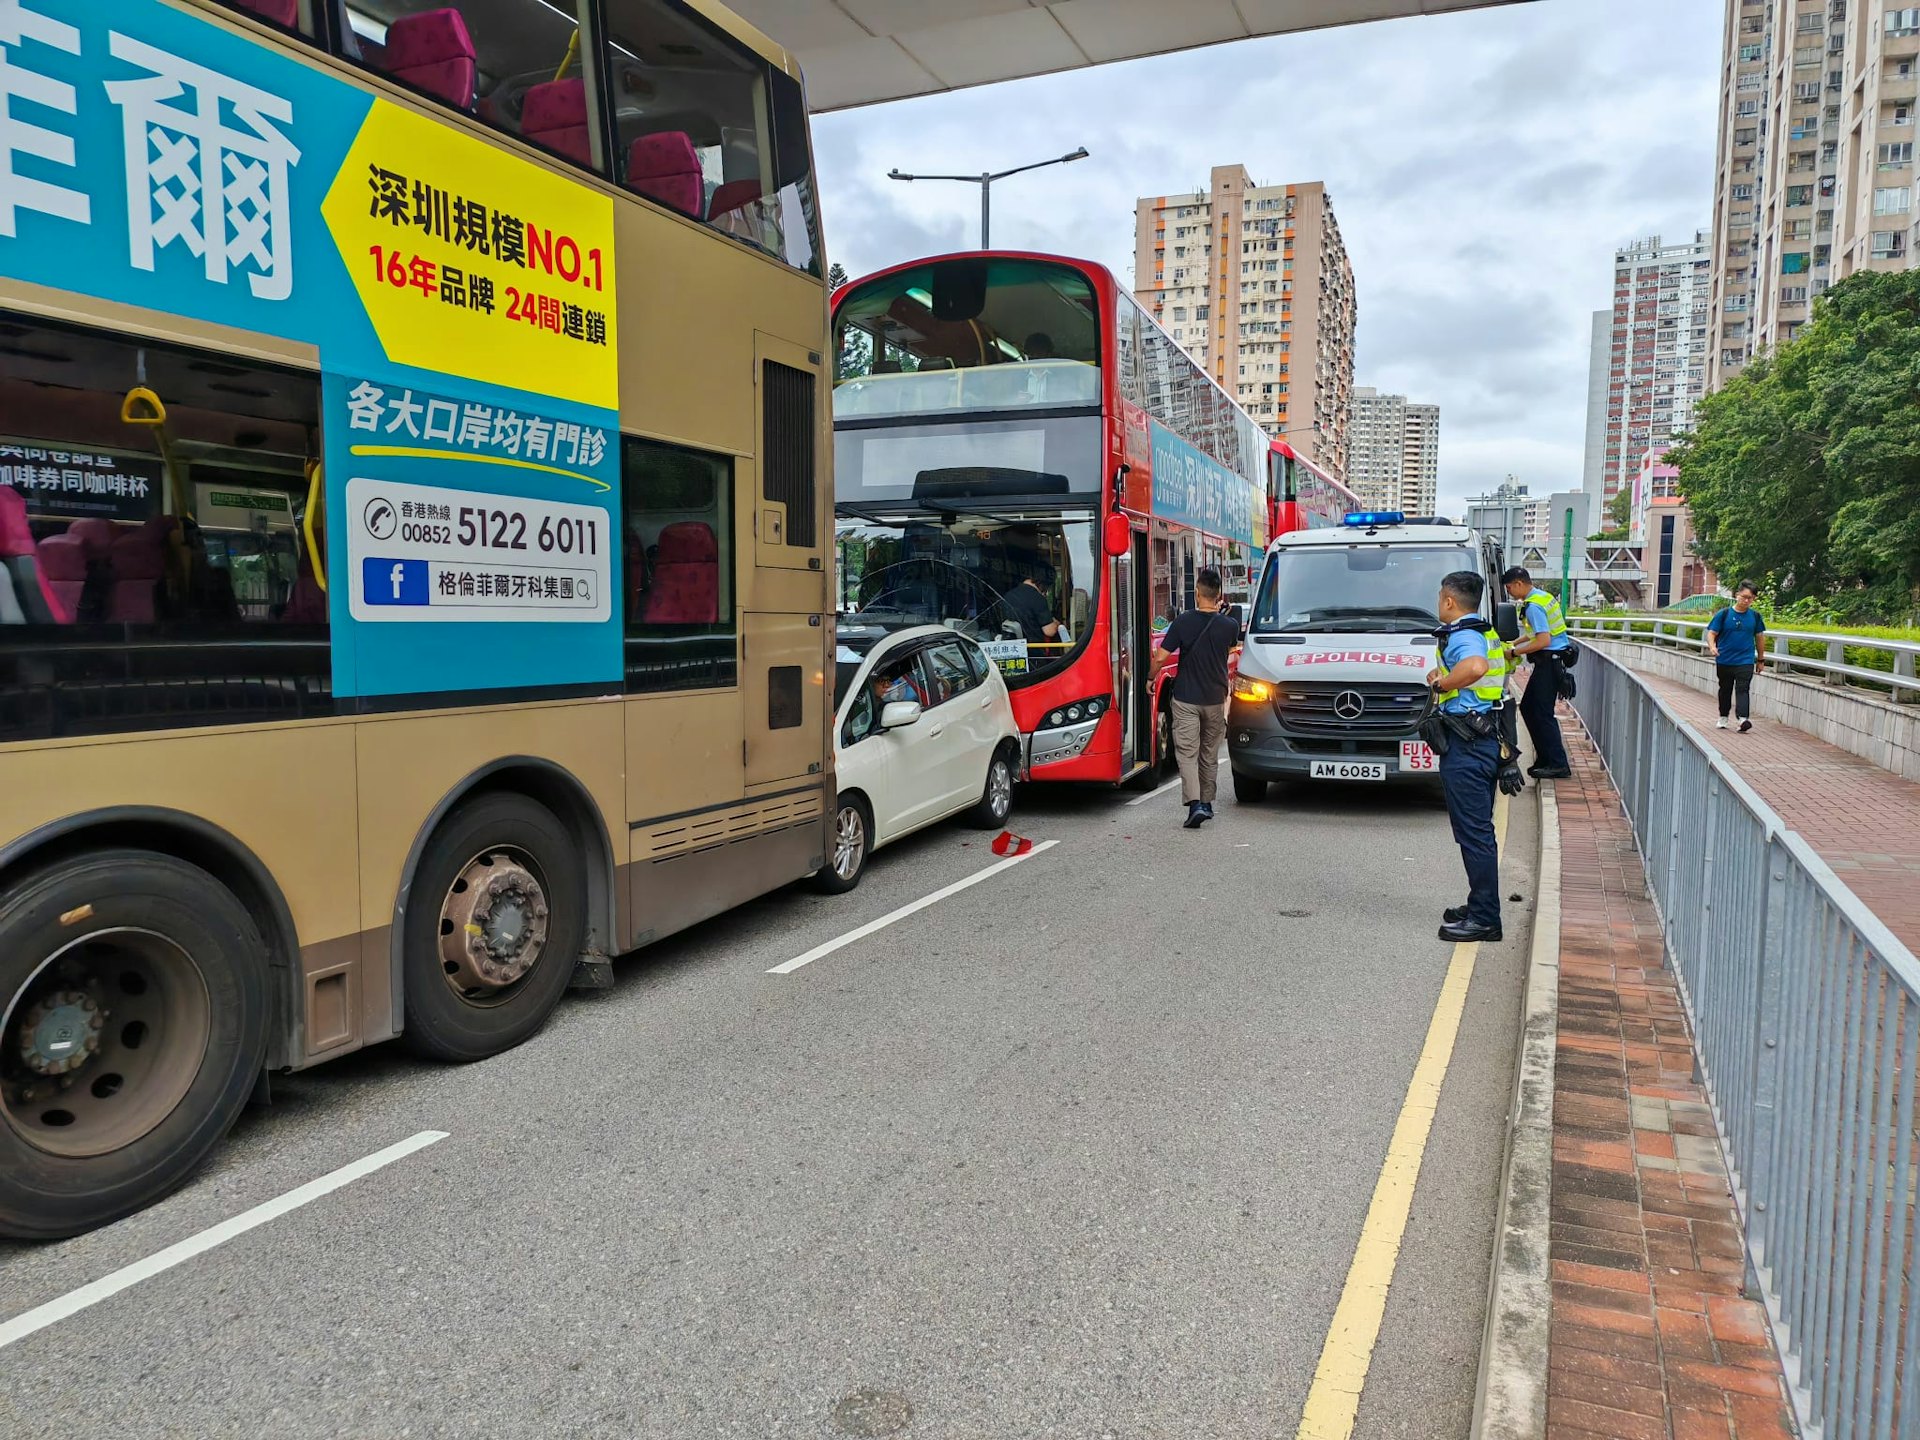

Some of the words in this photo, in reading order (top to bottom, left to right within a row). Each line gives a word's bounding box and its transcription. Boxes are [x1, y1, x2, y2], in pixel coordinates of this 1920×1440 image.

[369, 245, 496, 316] 16年品牌
[504, 287, 607, 347] 24間連鎖
[347, 381, 608, 467] 各大口岸均有門診
[401, 501, 451, 521] 香港熱線
[401, 523, 451, 544] 00852
[457, 507, 528, 550] 5122
[537, 516, 597, 555] 6011
[438, 571, 574, 599] 格倫菲爾牙科集團
[1315, 764, 1336, 776] AM
[1340, 766, 1381, 778] 6085
[1410, 756, 1432, 769] 53
